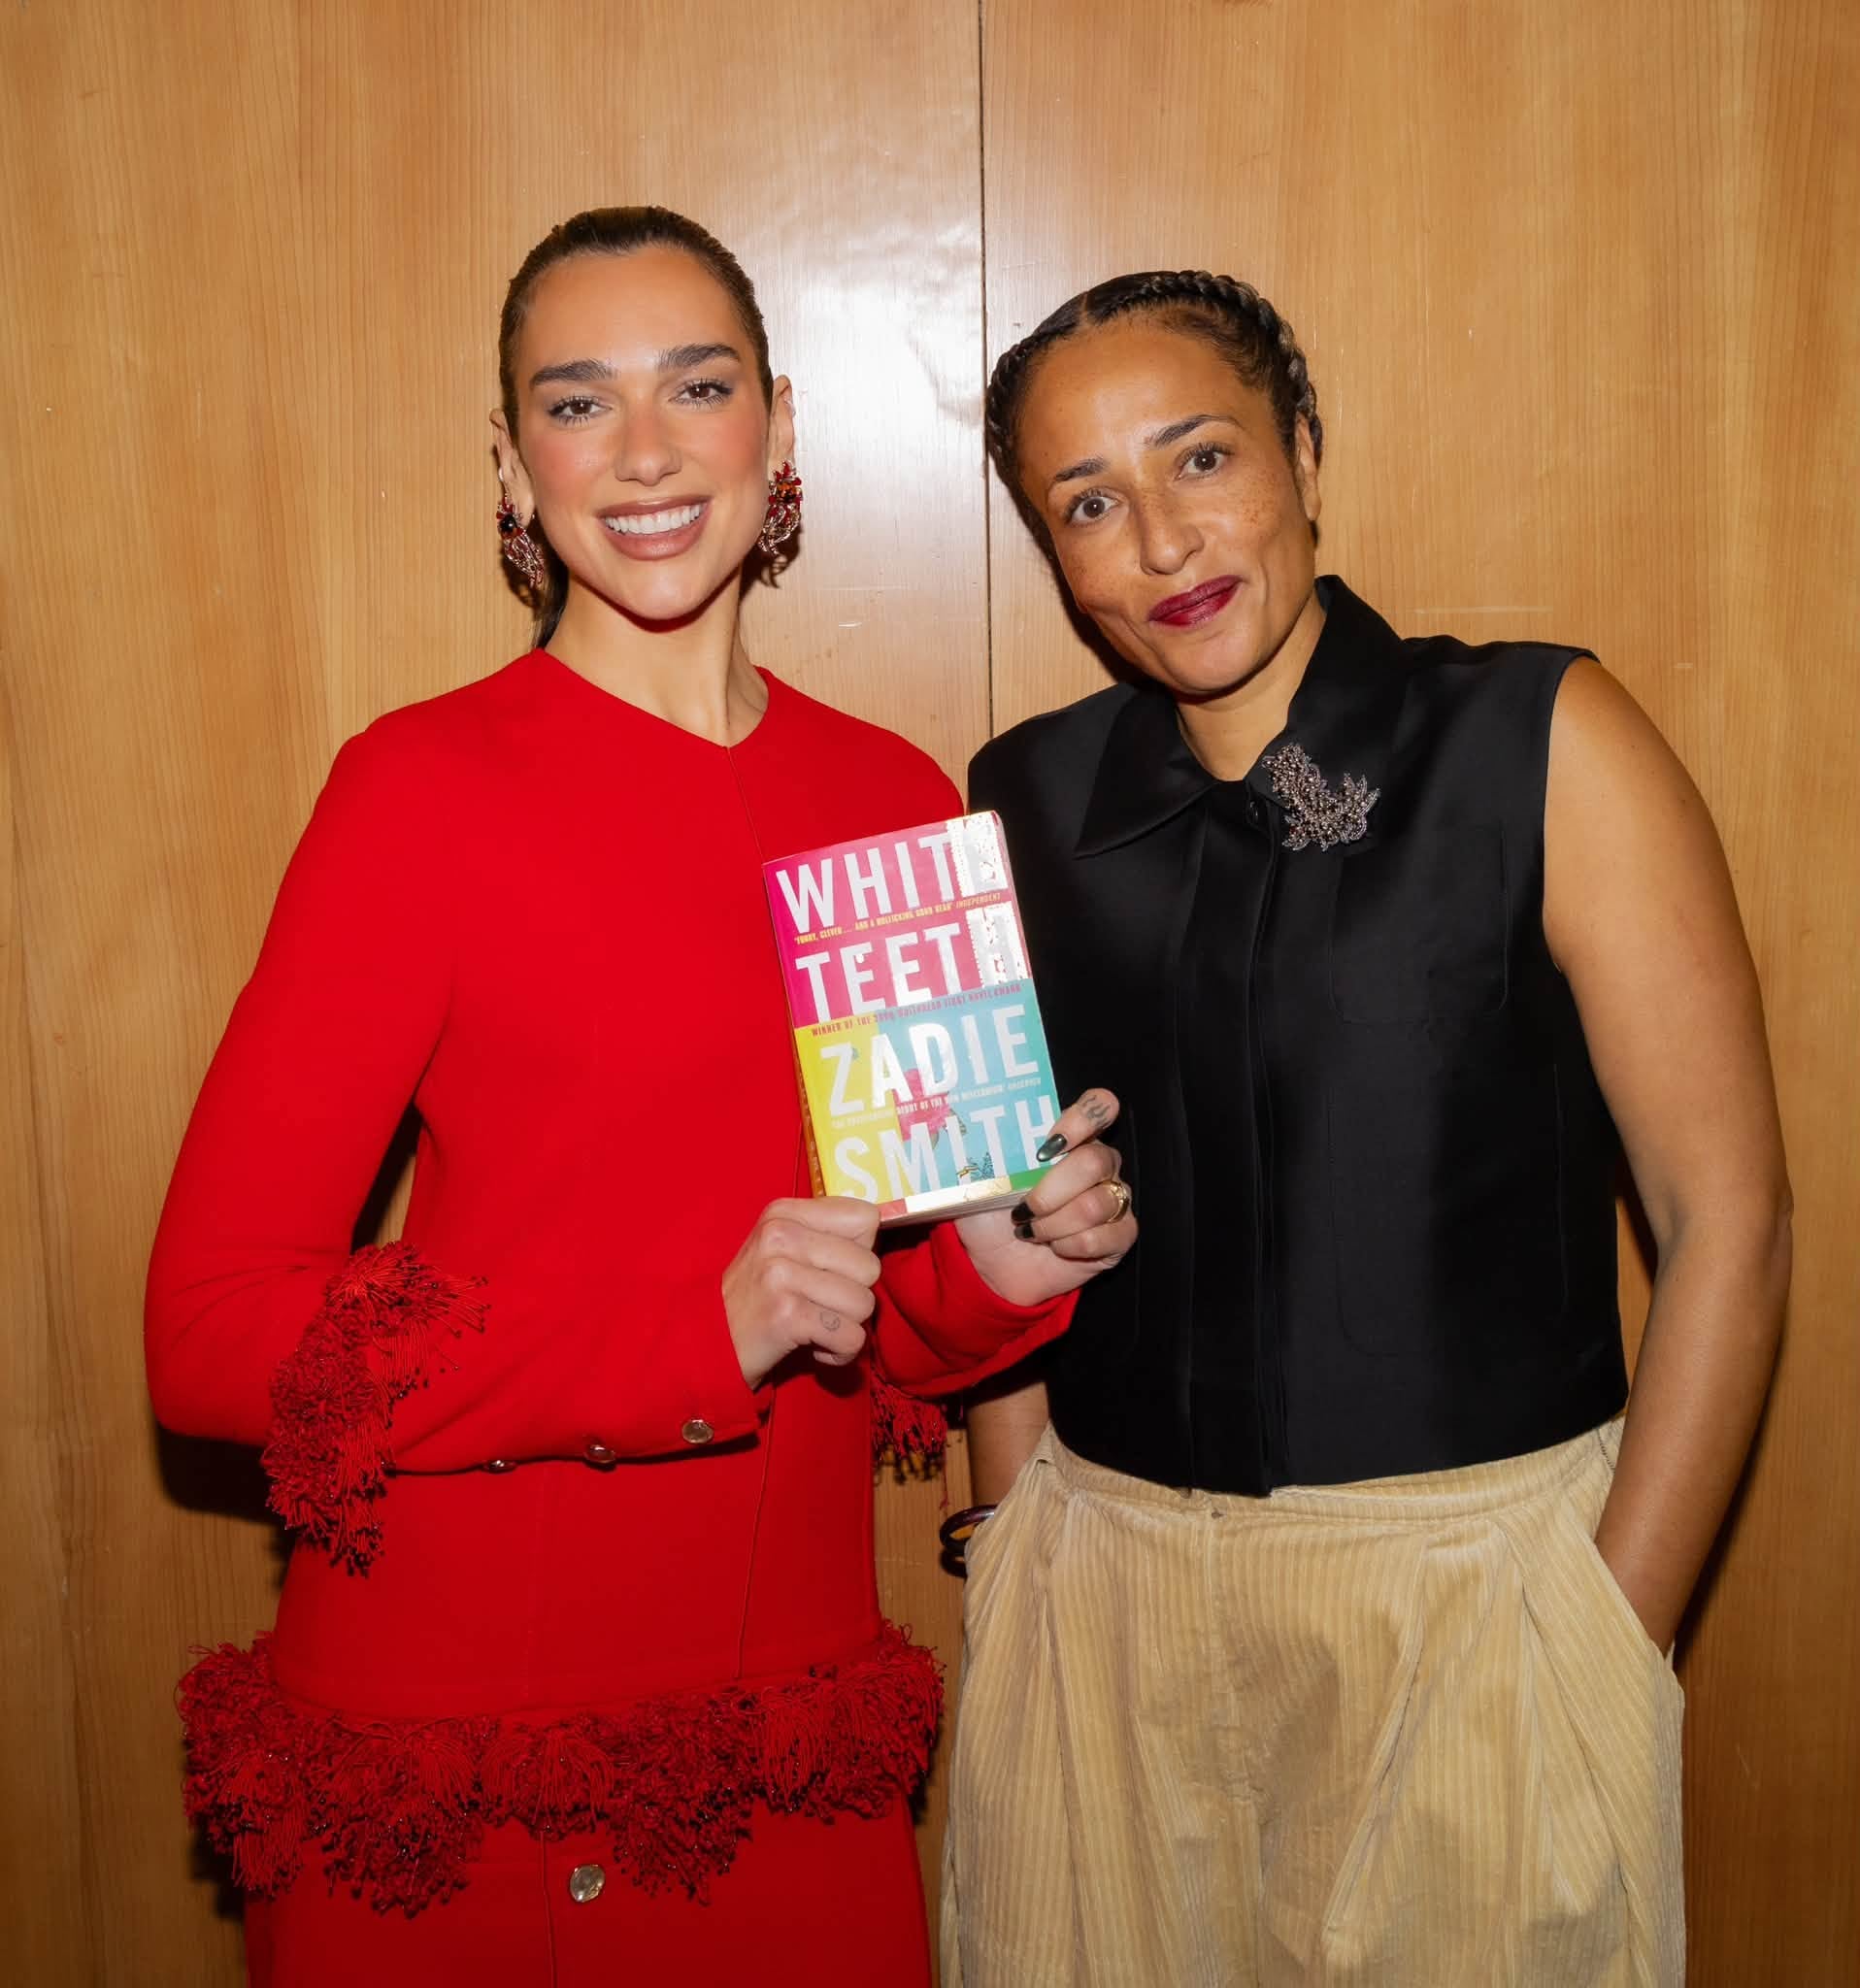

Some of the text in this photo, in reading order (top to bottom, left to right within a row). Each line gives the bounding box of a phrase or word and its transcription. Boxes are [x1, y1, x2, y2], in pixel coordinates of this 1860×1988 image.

[795, 904, 1022, 1024] TEETH
[812, 1024, 842, 1037] WINNER
[845, 1021, 854, 1032] OF
[857, 1016, 872, 1028] THE
[945, 995, 967, 1008] FIRST
[820, 1006, 1039, 1116] ZADIE
[920, 1100, 931, 1112] OF
[834, 1094, 1066, 1204] SMITH
